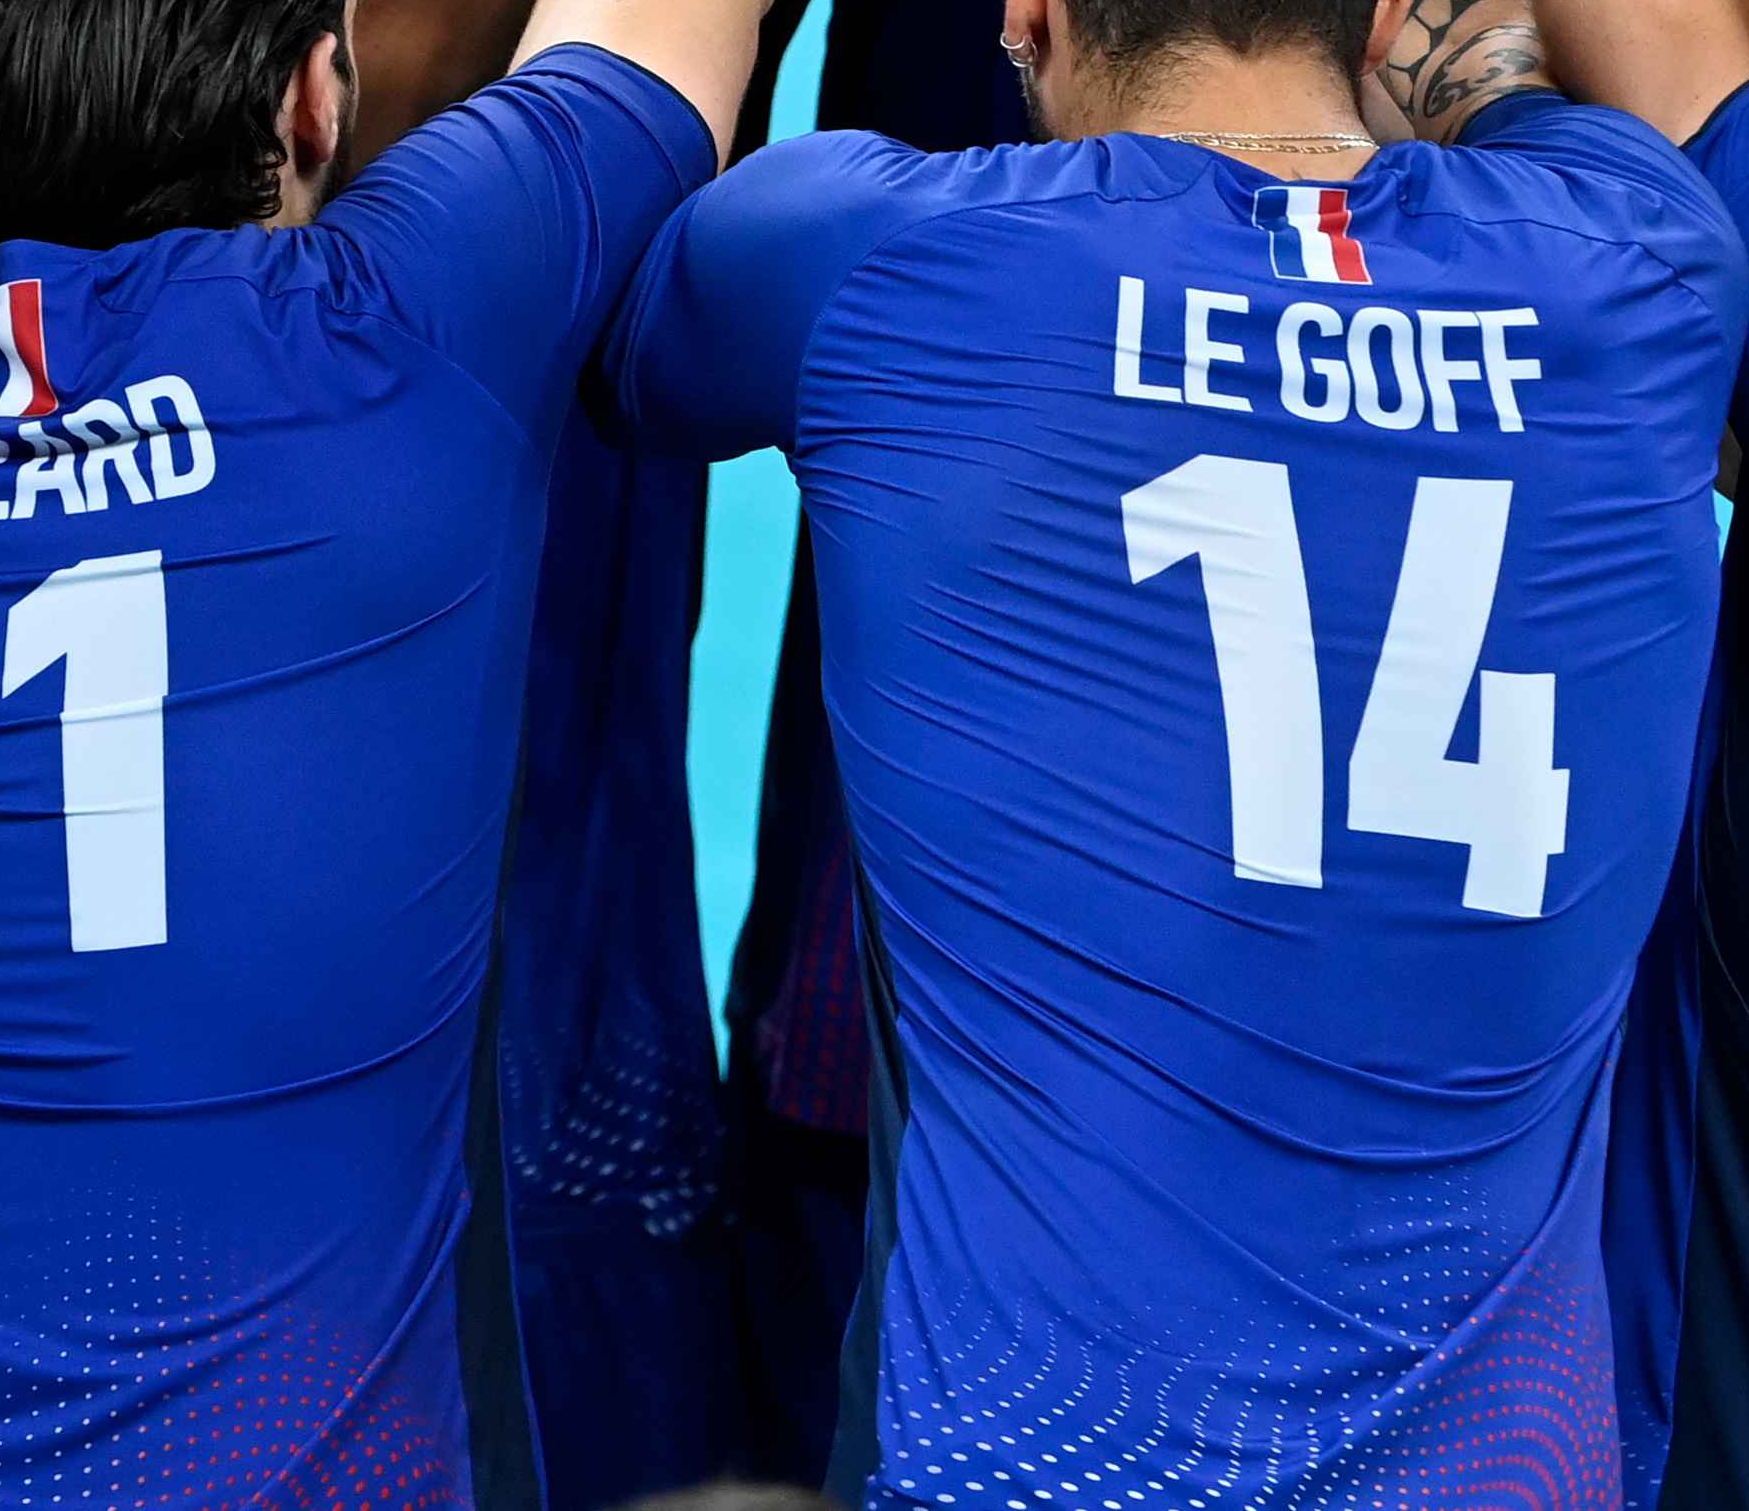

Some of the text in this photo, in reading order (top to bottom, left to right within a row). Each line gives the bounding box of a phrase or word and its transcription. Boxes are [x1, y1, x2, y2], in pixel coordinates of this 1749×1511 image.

[1113, 275, 1543, 433] LE GOFF
[1120, 453, 1571, 919] 14
